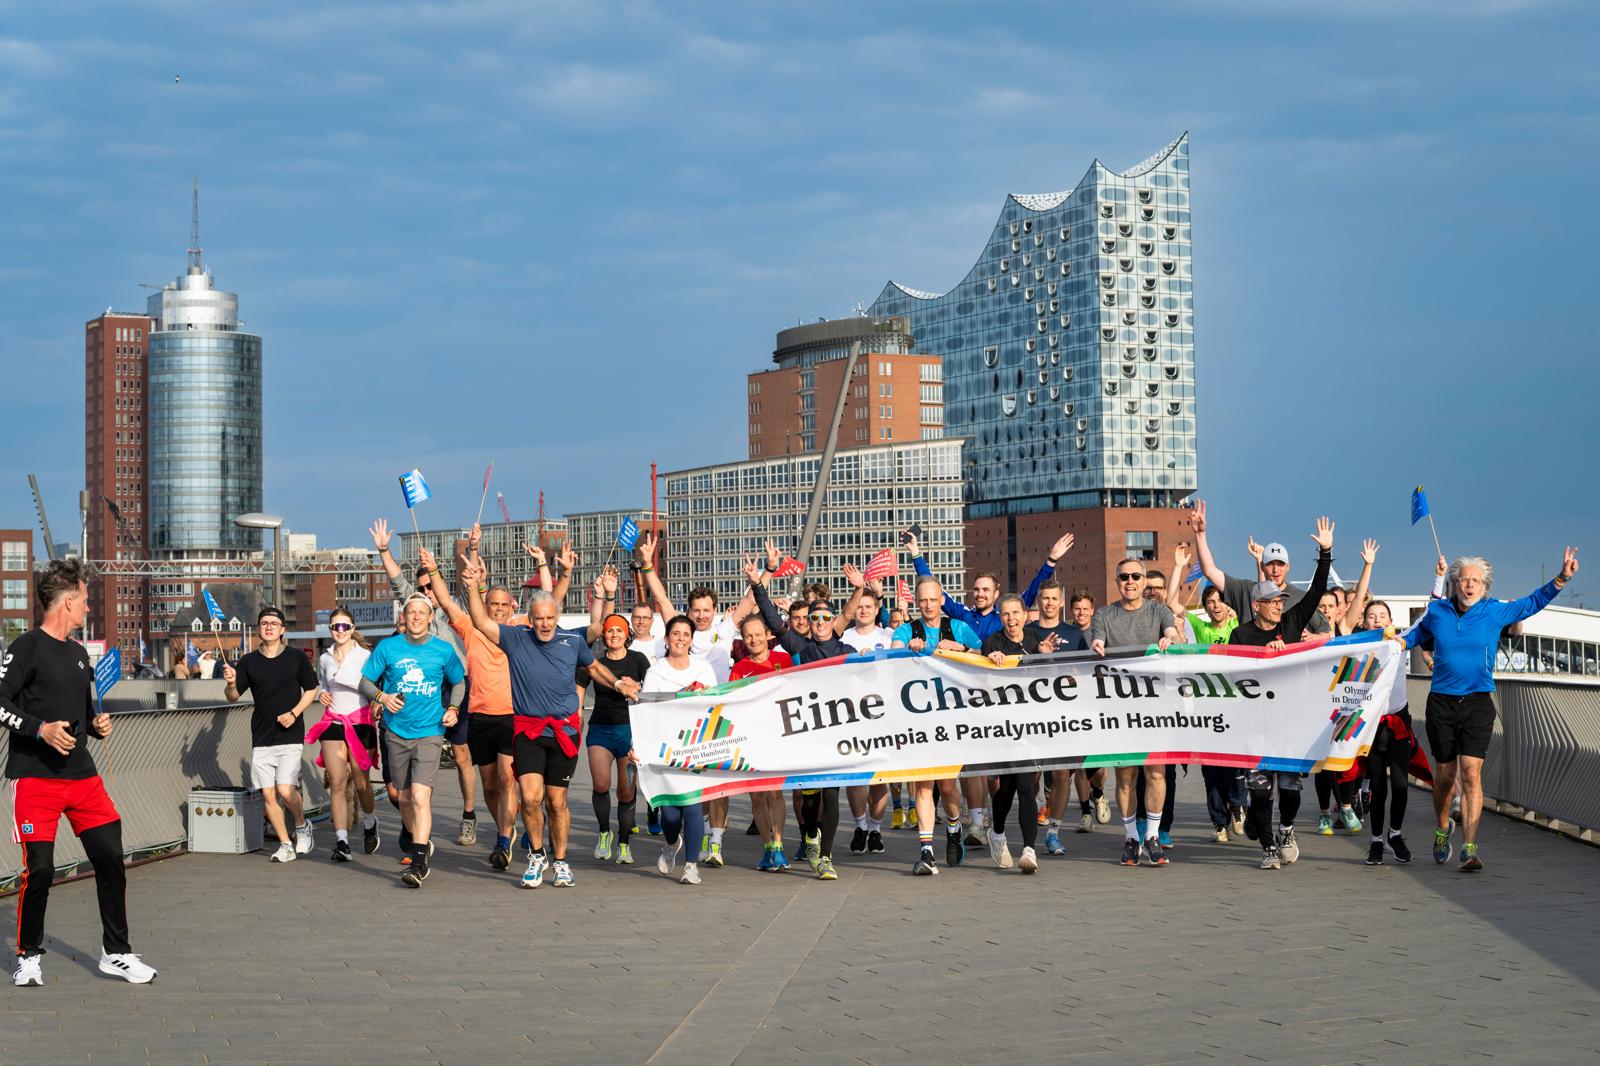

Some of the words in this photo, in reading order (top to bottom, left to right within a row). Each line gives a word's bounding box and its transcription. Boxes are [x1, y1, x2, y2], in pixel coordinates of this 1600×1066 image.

[775, 691, 885, 737] Eine
[900, 674, 1078, 713] Chance
[1092, 664, 1160, 699] für
[1176, 672, 1275, 700] alle.
[1332, 695, 1340, 703] in
[708, 736, 748, 749] Paralympics
[836, 728, 928, 756] Olympia
[935, 725, 949, 741] &
[956, 715, 1093, 743] Paralympics
[1099, 712, 1120, 730] in
[1127, 711, 1230, 733] Hamburg.
